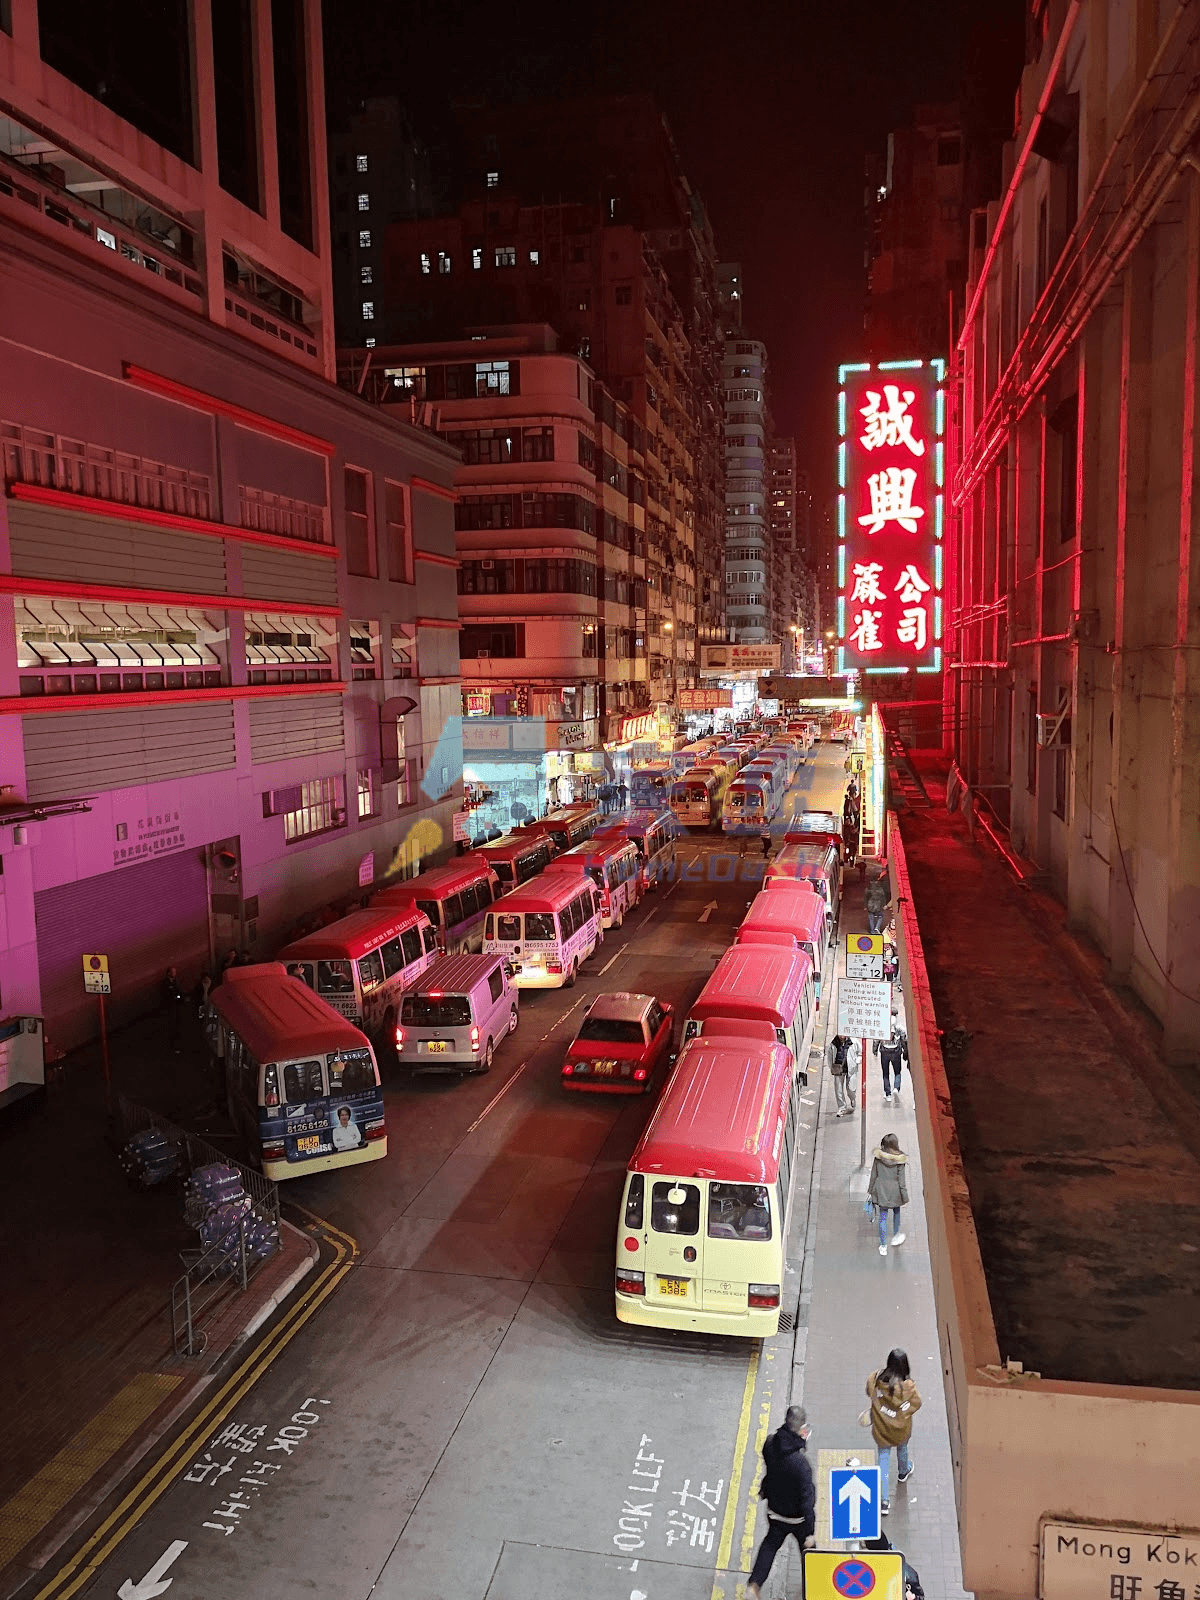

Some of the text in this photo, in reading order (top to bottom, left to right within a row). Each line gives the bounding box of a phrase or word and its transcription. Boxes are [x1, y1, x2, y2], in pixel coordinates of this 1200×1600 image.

[858, 384, 925, 535] 誠興
[893, 564, 930, 651] 公司
[869, 955, 876, 964] 7
[870, 969, 881, 977] 12
[101, 984, 109, 992] 12
[843, 987, 866, 995] waiting
[847, 994, 881, 1002] prosecuted
[847, 1007, 881, 1017] 停車等候
[287, 1123, 307, 1133] 8126
[308, 1119, 329, 1130] 8126
[661, 1285, 686, 1296] 5385
[267, 1397, 332, 1456] LOOK
[1057, 1535, 1199, 1567] Mong Kok
[1110, 1574, 1200, 1600] 旺角
